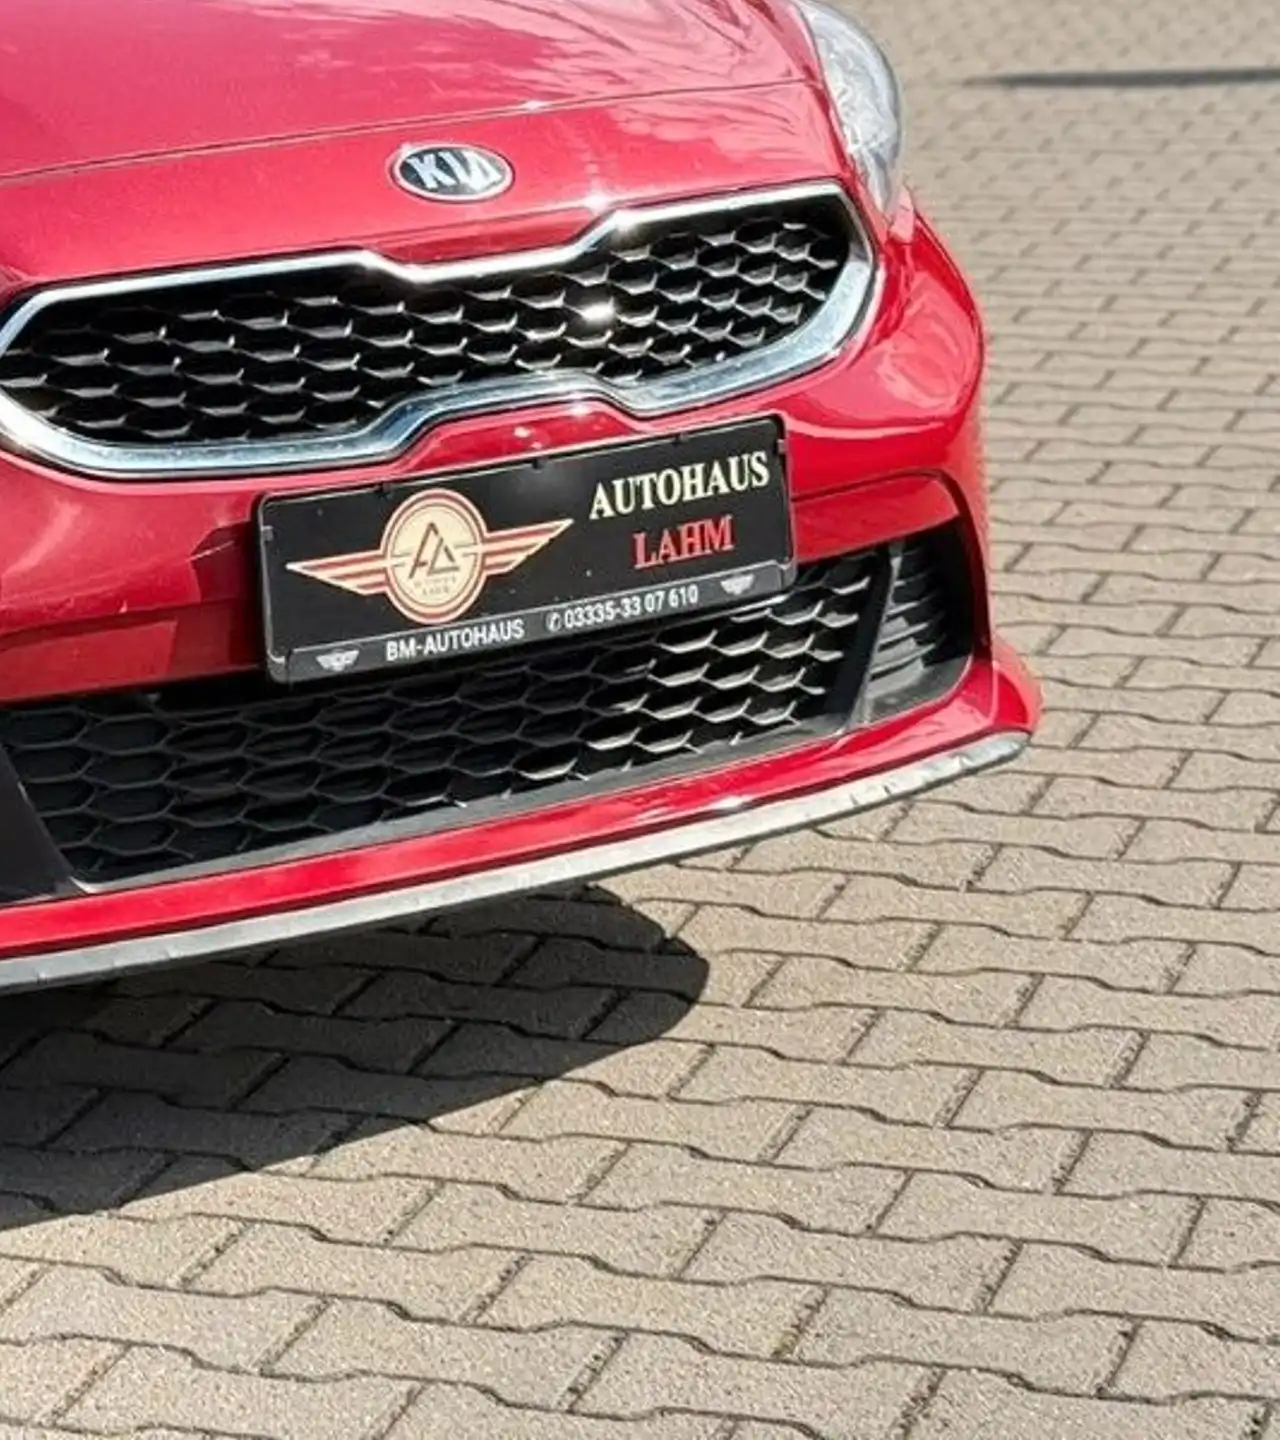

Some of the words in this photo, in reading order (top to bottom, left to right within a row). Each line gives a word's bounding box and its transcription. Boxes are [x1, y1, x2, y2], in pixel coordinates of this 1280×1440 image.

[405, 149, 502, 191] KIA
[589, 450, 770, 520] AUTOHAUS
[633, 513, 734, 570] LAHM
[386, 618, 525, 661] BM-AUTOHAUS
[564, 596, 641, 628] 03335-33
[644, 590, 665, 613] 07
[668, 583, 699, 608] 610
